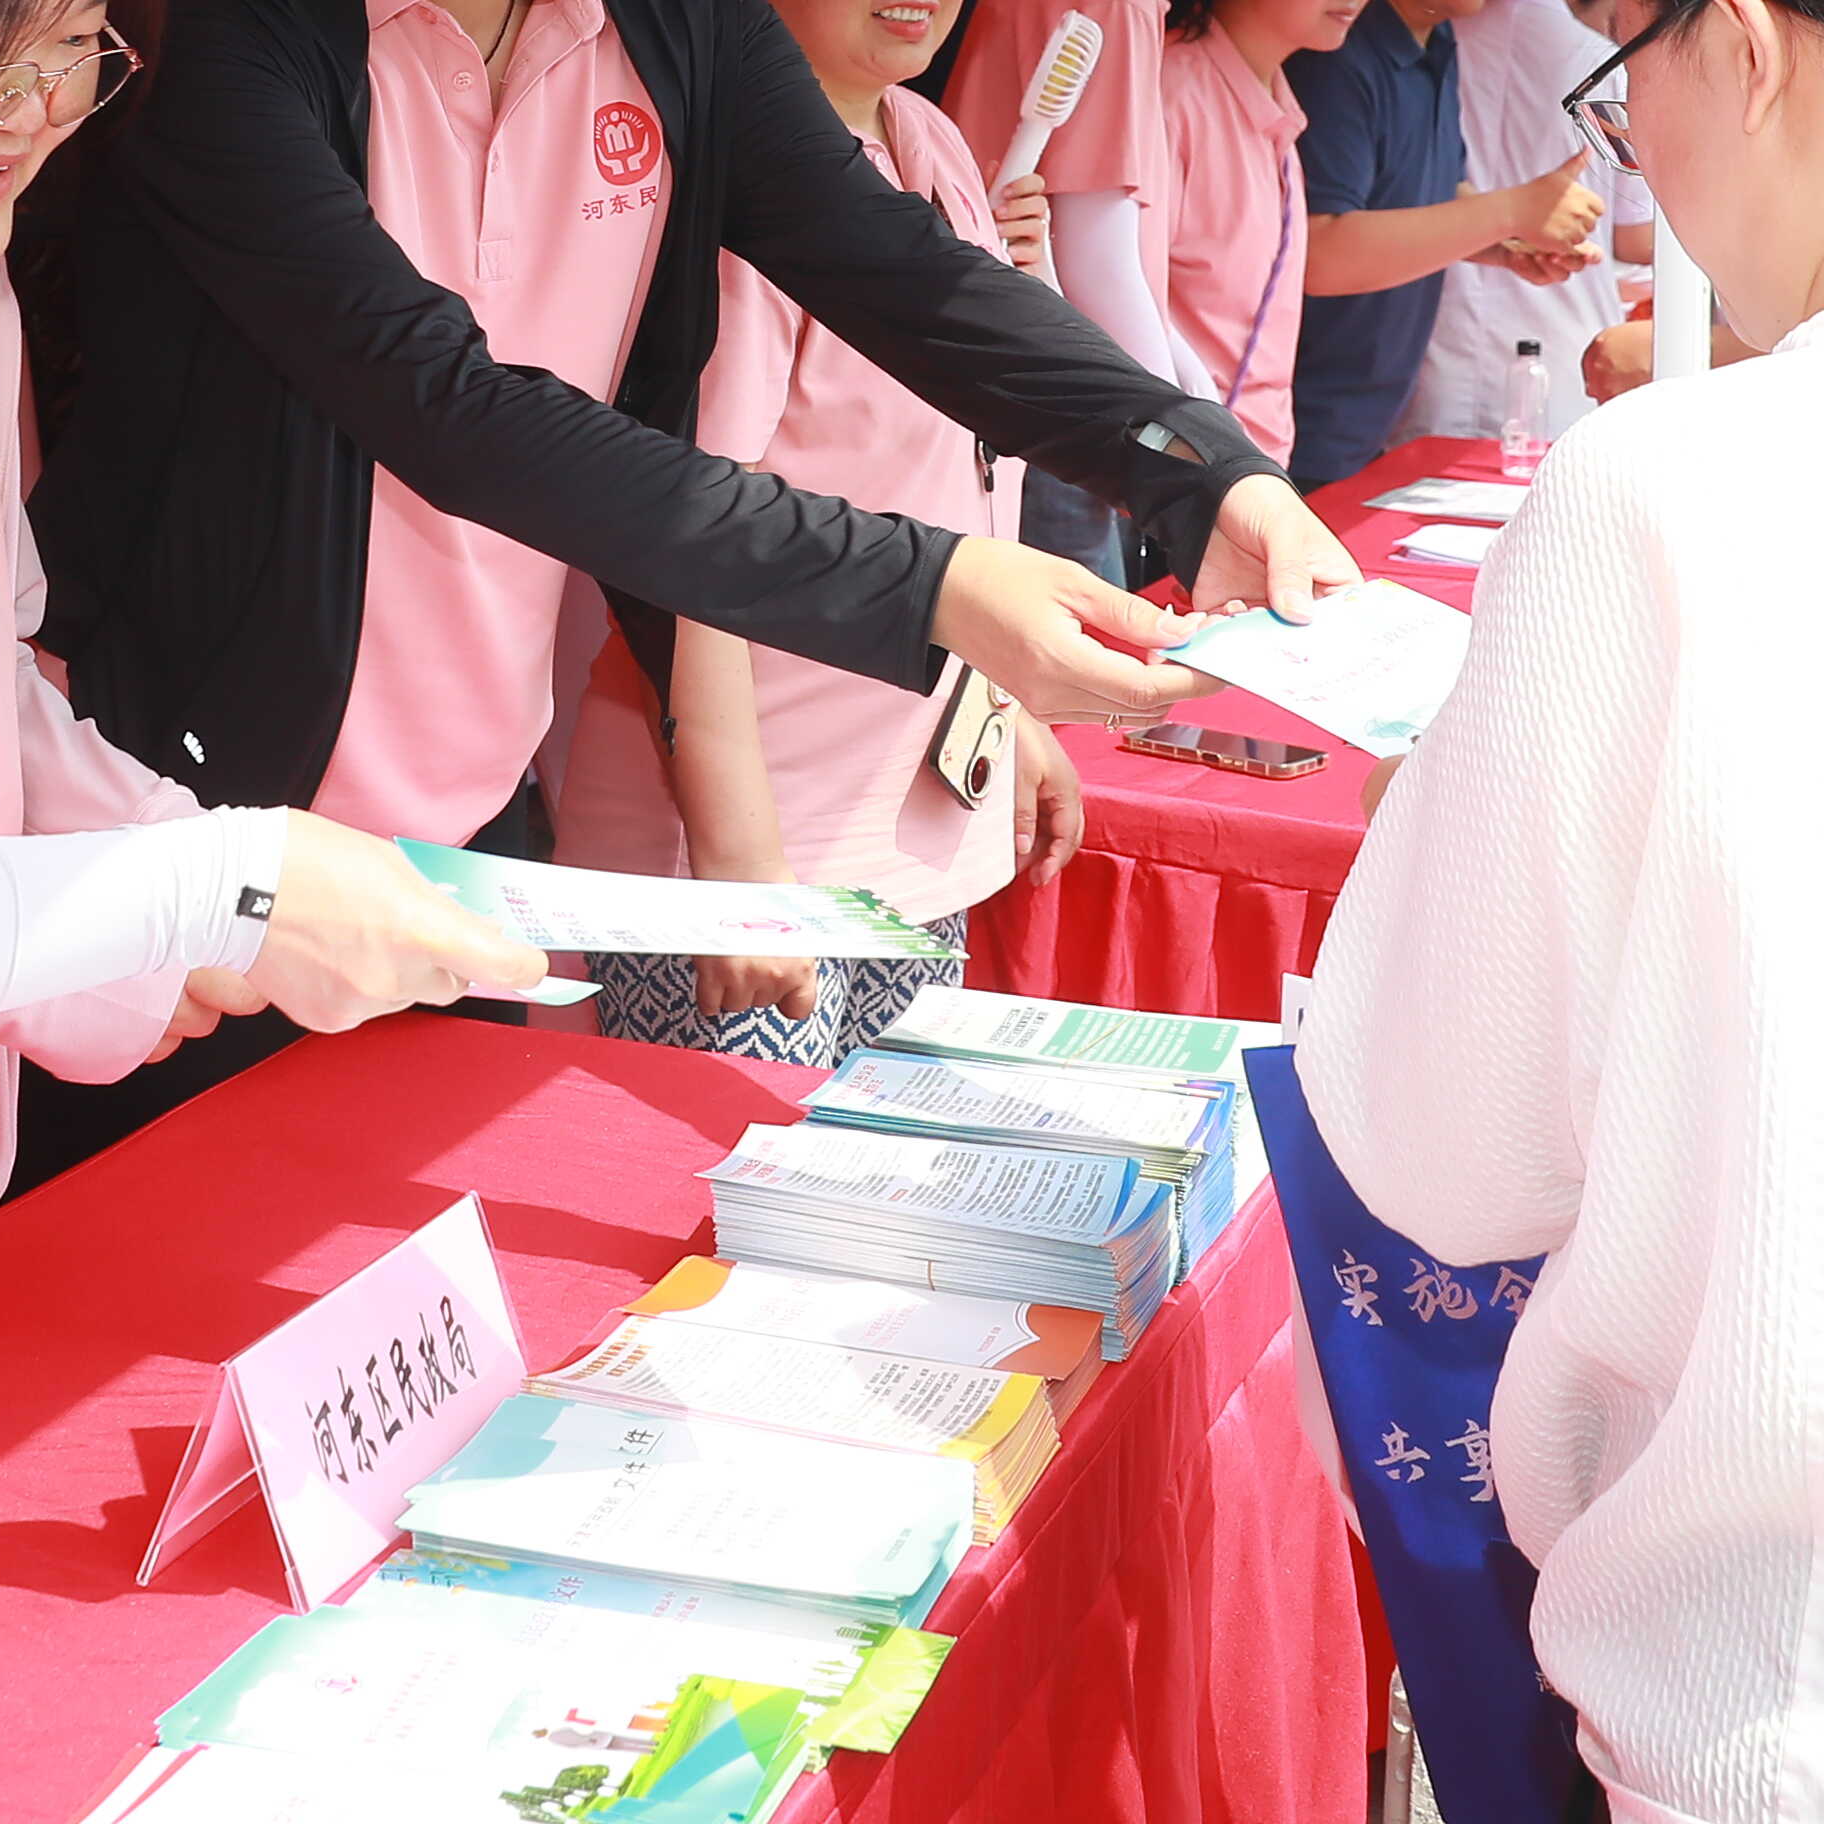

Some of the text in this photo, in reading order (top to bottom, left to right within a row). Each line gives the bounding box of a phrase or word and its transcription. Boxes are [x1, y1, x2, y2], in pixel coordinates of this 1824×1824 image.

[582, 186, 656, 220] 河东民
[305, 1295, 477, 1484] 河东区民政局
[1375, 1419, 1495, 1502] 共享
